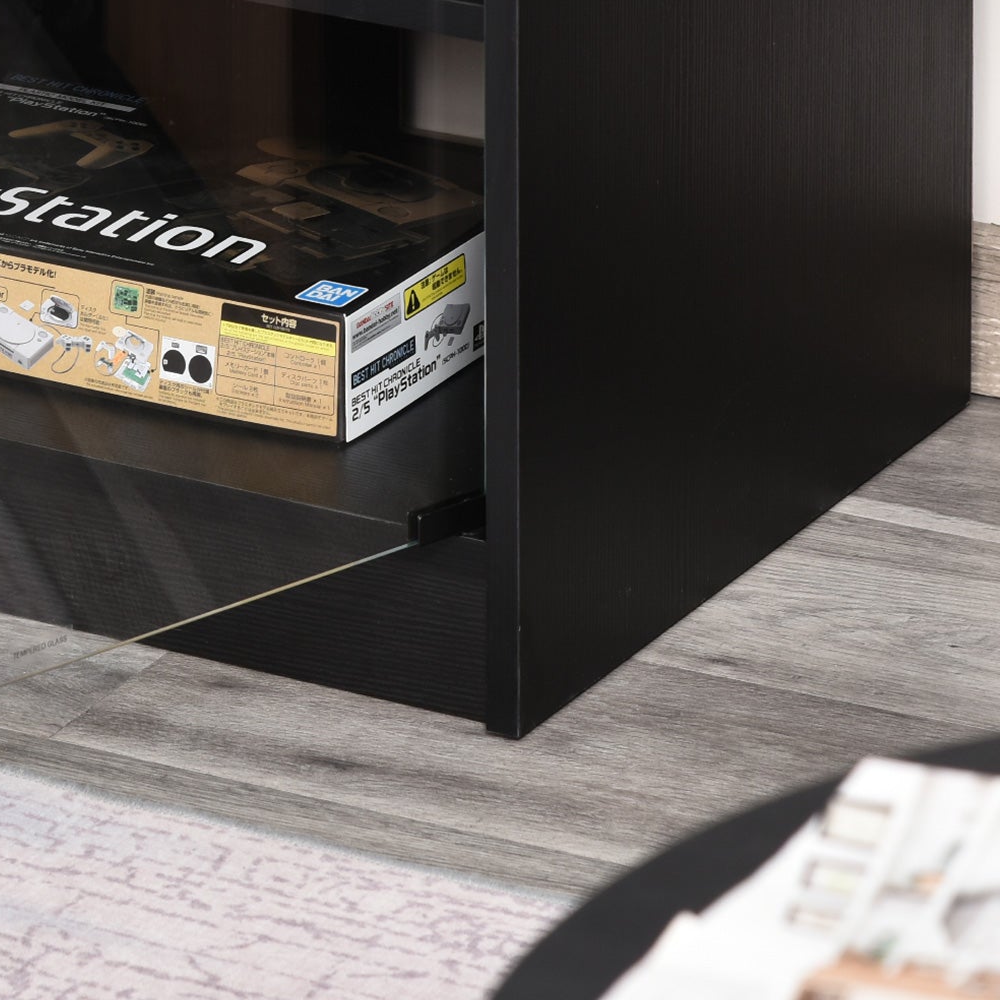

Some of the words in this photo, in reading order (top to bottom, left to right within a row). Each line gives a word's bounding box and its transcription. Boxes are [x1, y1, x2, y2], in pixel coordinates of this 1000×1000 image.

[306, 291, 341, 302] DAI
[318, 284, 358, 298] BAN
[260, 313, 298, 329] セット内容
[352, 369, 369, 387] BEST
[369, 362, 381, 377] HIT
[381, 340, 415, 368] CHRONICLE
[351, 390, 370, 408] BEST
[371, 381, 383, 396] HIT
[383, 357, 421, 388] CHRONICLE
[352, 400, 371, 422] 2/5
